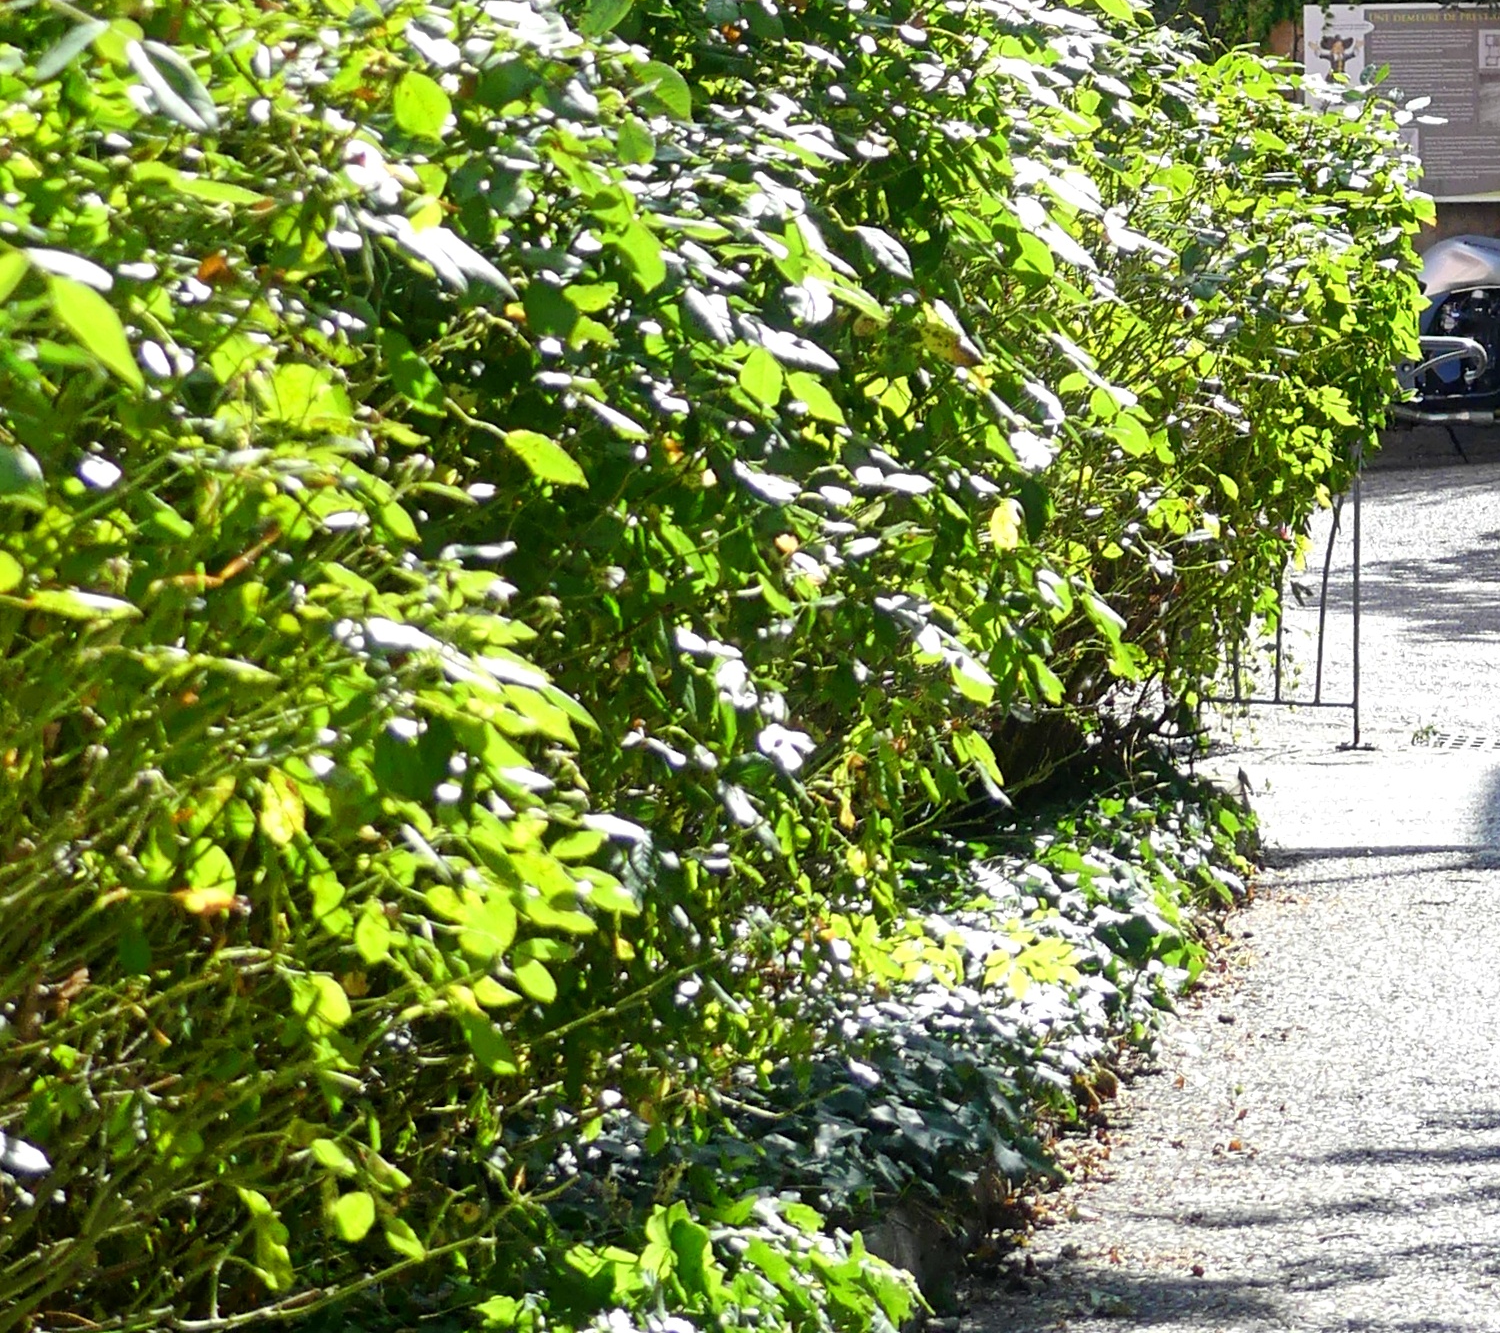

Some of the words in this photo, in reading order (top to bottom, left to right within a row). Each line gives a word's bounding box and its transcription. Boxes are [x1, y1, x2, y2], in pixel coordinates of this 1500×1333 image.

[1369, 12, 1389, 22] UNE
[1393, 12, 1439, 23] DEMEURE
[1443, 12, 1457, 22] DE
